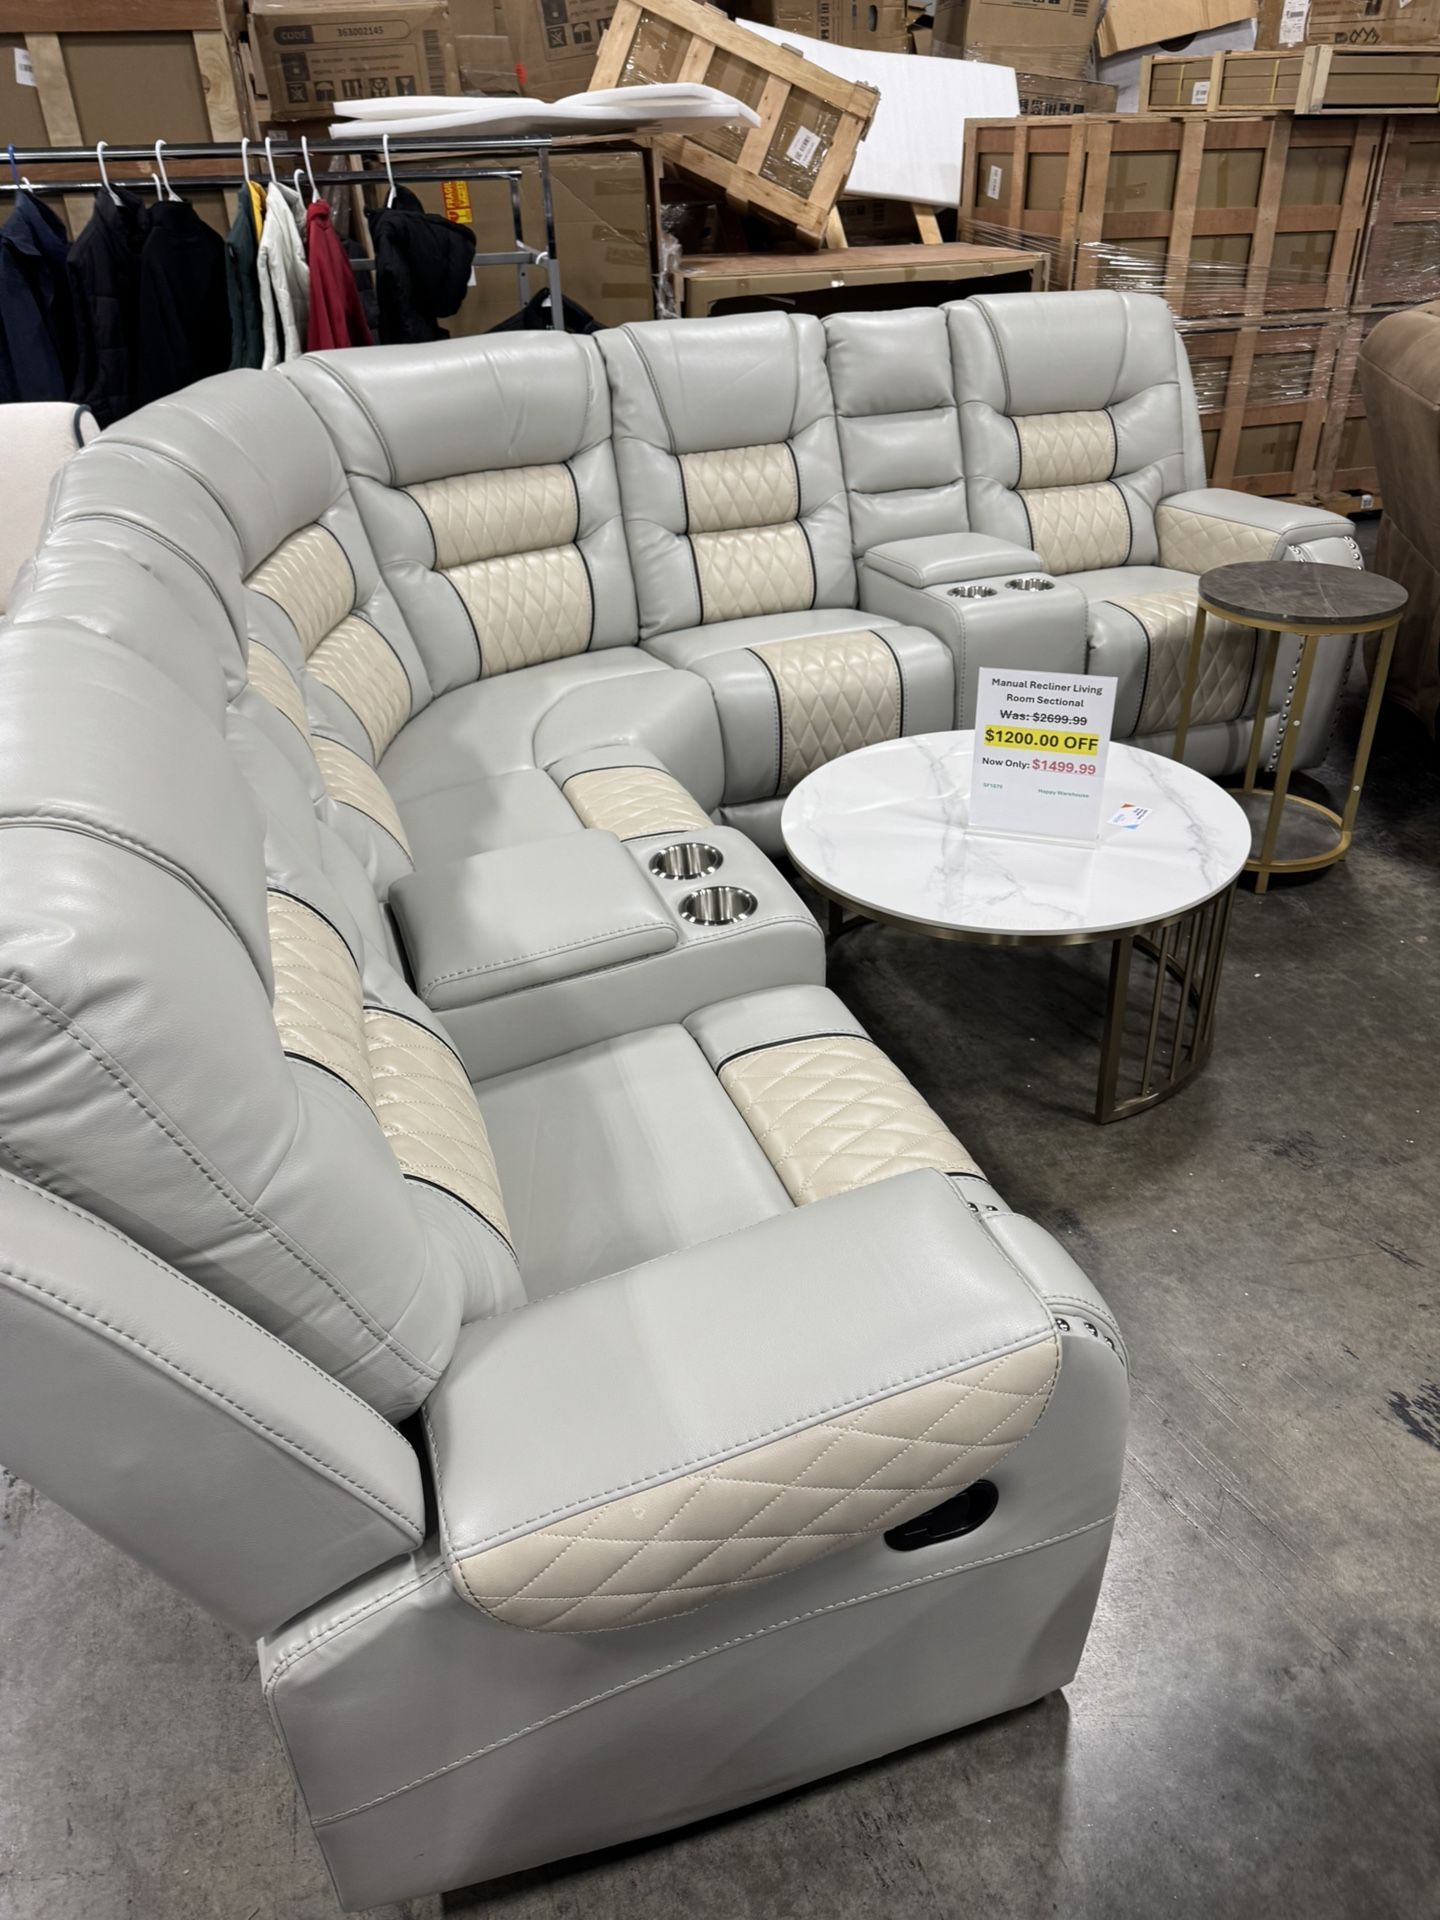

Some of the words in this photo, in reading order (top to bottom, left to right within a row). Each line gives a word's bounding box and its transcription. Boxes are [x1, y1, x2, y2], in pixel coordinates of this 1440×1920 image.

[280, 31, 307, 40] CODE
[443, 181, 455, 209] FRAGIL
[991, 678, 1028, 688] Manual
[1029, 681, 1071, 692] Recliner
[1073, 684, 1103, 696] Living
[1006, 693, 1035, 703] Room
[1037, 696, 1084, 707] Sectional
[1000, 709, 1030, 721] Was:
[1032, 712, 1087, 726] $2699.99
[985, 728, 1059, 747] $1200.00
[1064, 736, 1099, 751] OFF
[982, 757, 1003, 766] Now
[1005, 759, 1030, 770] Only:
[1032, 758, 1096, 775] $1499.99
[1038, 788, 1056, 796] Happy
[1057, 790, 1089, 798] Warehouse
